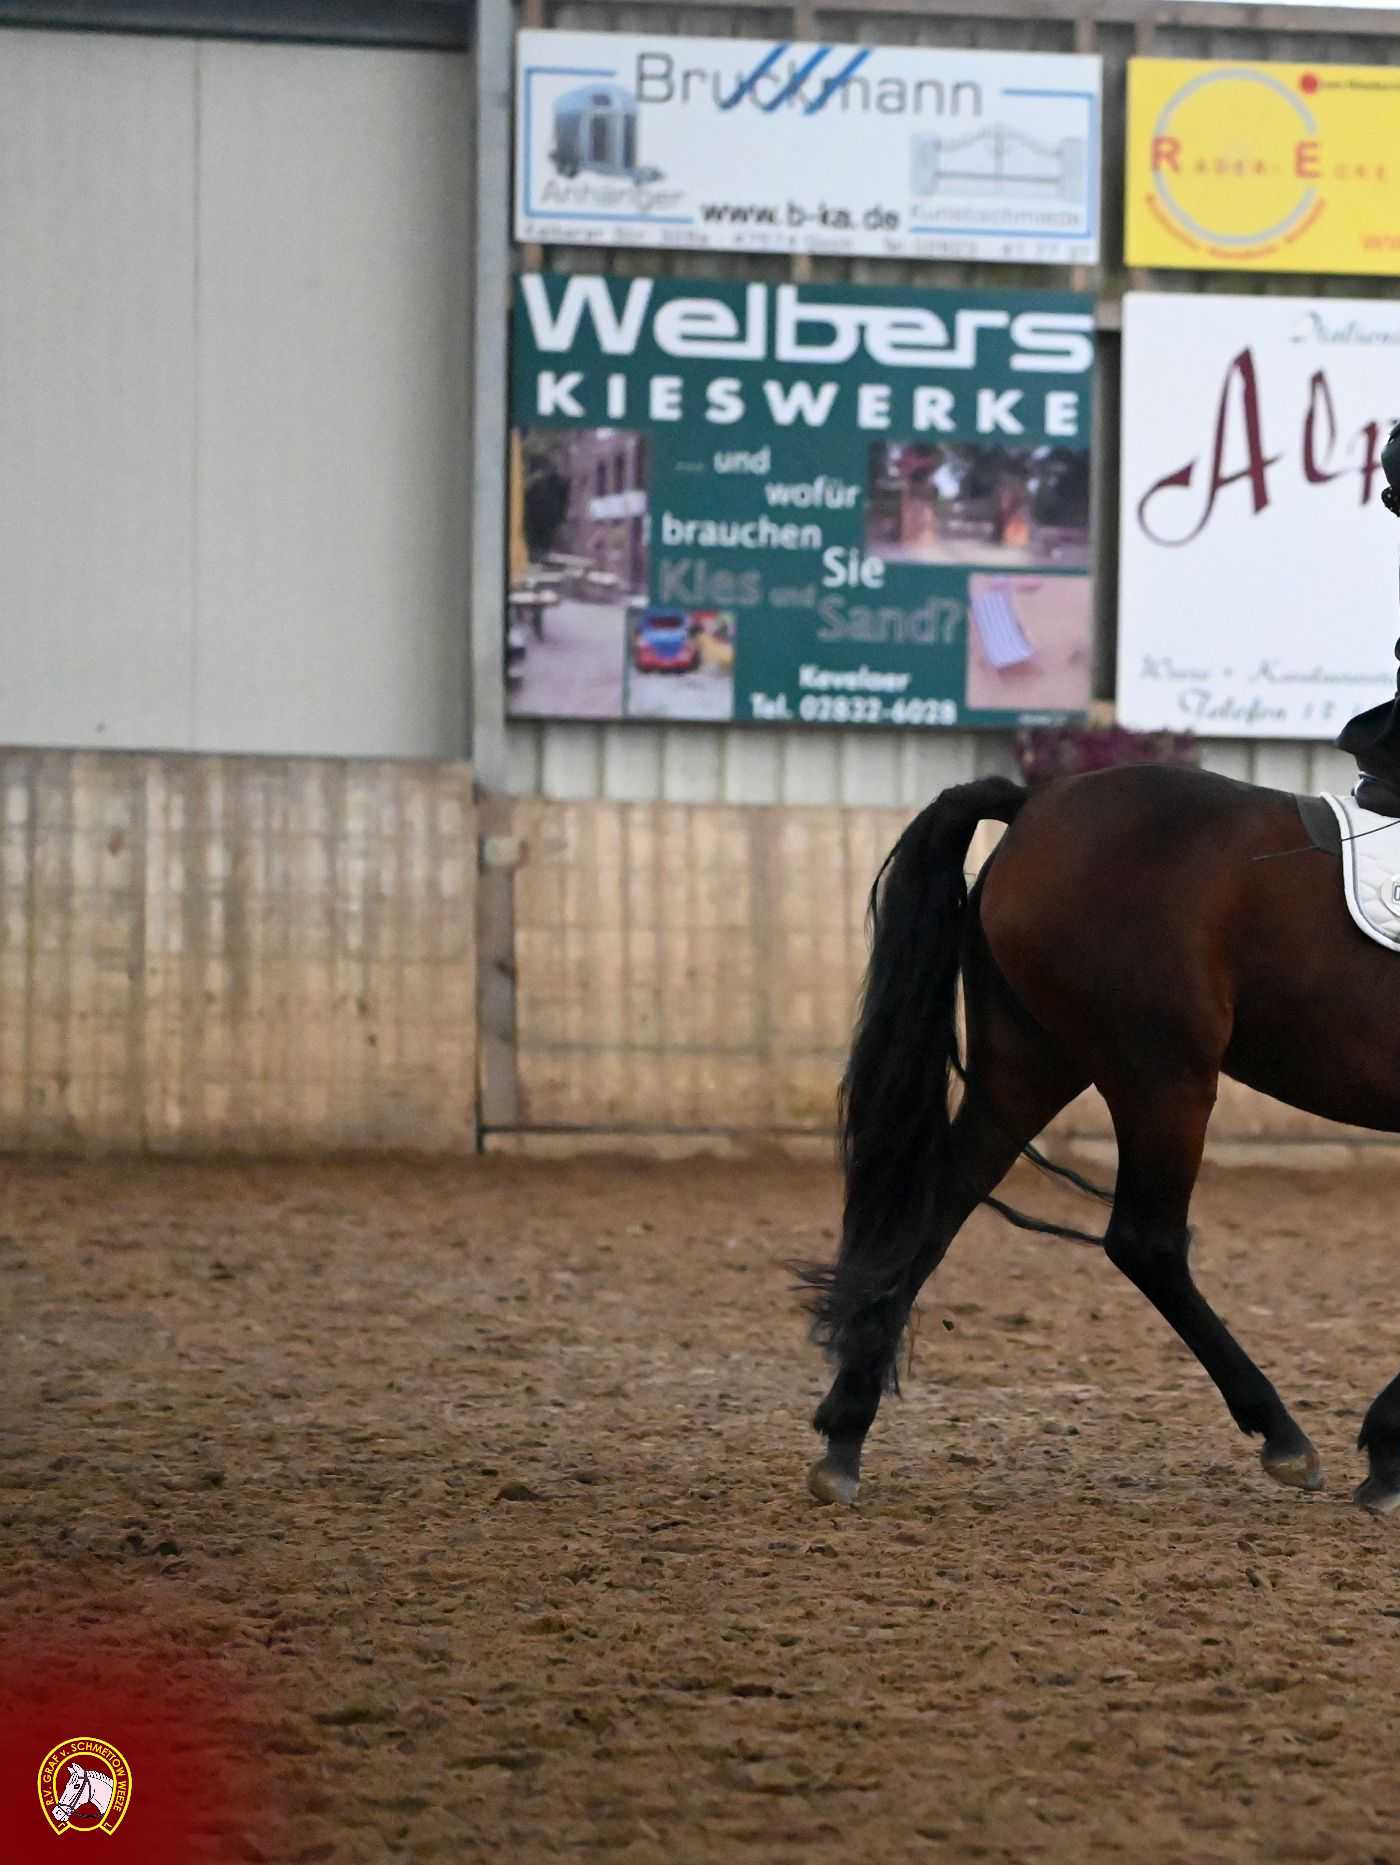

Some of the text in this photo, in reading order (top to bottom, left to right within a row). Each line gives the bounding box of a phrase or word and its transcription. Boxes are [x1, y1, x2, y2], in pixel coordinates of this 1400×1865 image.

[701, 199, 899, 230] www.b-ka.de
[521, 273, 1096, 373] Welbers
[537, 371, 1079, 436] KIESWERKE
[713, 445, 772, 475] und
[764, 475, 861, 509] wofür
[661, 510, 823, 549] brauchen
[822, 547, 886, 588] Sie
[660, 558, 761, 605] Kies
[816, 594, 962, 643] Sand?
